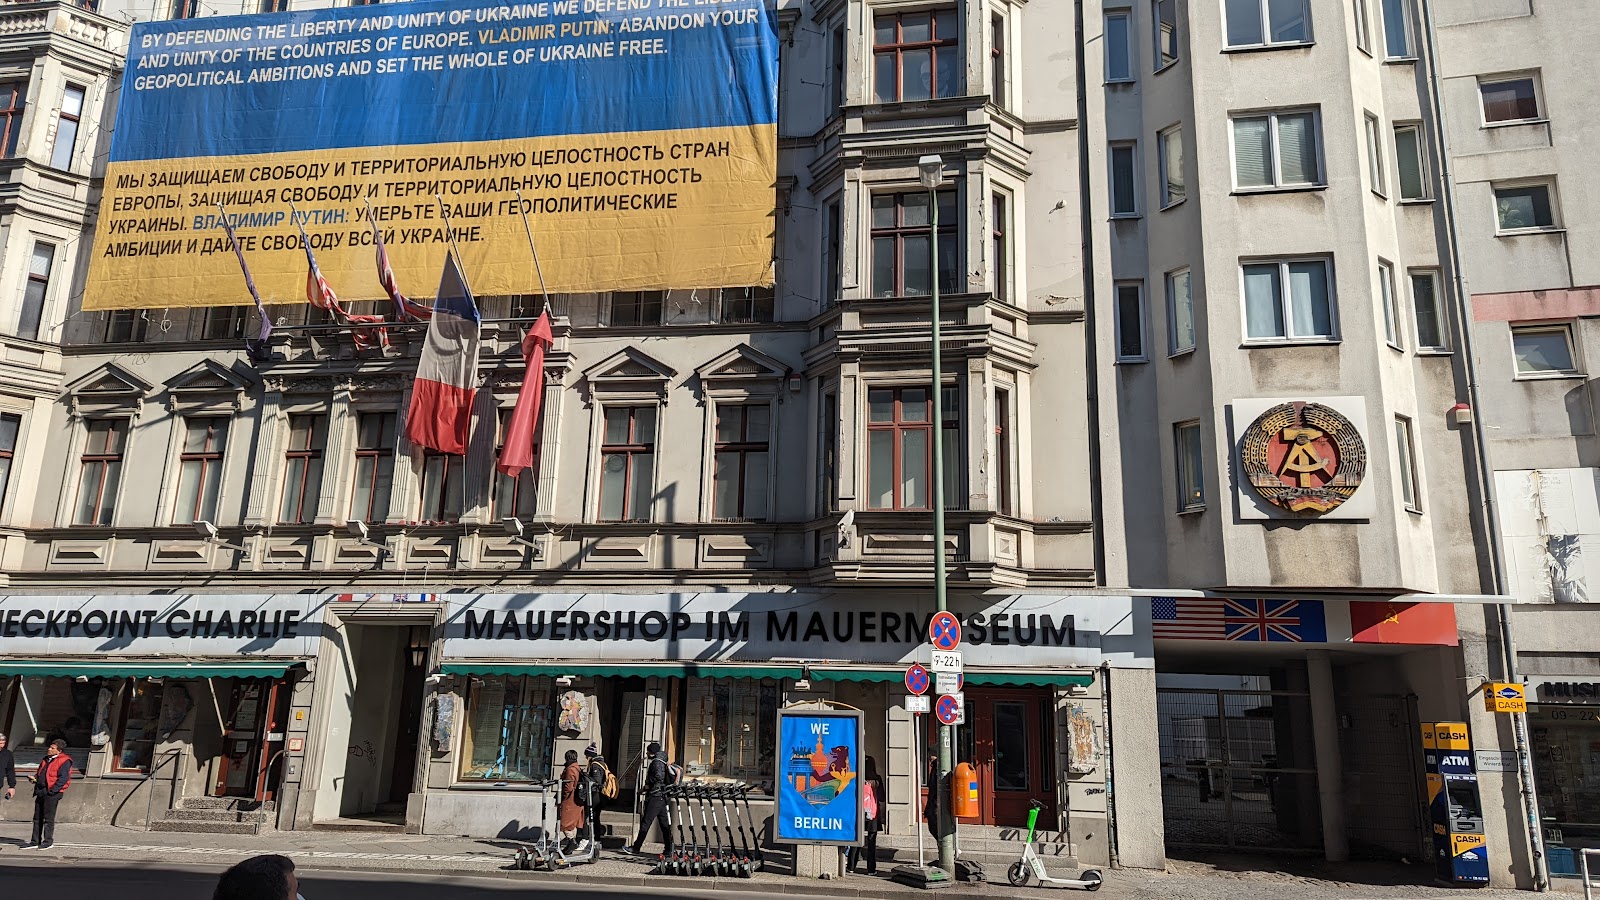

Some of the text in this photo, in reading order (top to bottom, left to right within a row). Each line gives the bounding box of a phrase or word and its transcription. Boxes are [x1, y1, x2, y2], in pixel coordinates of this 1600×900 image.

[137, 8, 759, 70] AND UNITY OF THE COUNTRIES OF EUROPE. VLADIMIR PUTIN: ABANDON YOUR
[142, 33, 163, 48] BY
[165, 26, 251, 46] DEFENDING
[256, 24, 286, 41] THE
[290, 18, 356, 38] LIBERTY
[359, 15, 393, 33] AND
[398, 11, 446, 31] UNITY
[449, 9, 471, 25] OF
[475, 4, 548, 22] UKRAINE
[553, 1, 579, 16] WE
[583, 0, 651, 14] DEFEND
[134, 38, 668, 91] GEOPOLITICAL AMBITIONS AND SET THE WHOLE OF UKRAINE FREE.
[117, 141, 730, 189] МЫ ЗАЩИЩАЕМ СВОБОДУ И ТЕРРИТОРИАЛЬНУЮ ЦЕЛОСТНОСТЬ СТРАН
[113, 168, 702, 212] ЕВРОПЫ, ЗАЩИЩАЯ СВОБОДУ И ТЕРРИТОРИАЛЬНУЮ ЦЕЛОСТНОСТЬ
[109, 216, 187, 235] УКРАИНЫ.
[193, 212, 285, 231] ВЛАДИМИР
[355, 204, 434, 222] УМЕРЬТЕ
[440, 202, 492, 219] ВАШИ
[499, 193, 678, 216] ГЕОПОЛИТИЧЕСКИЕ
[103, 239, 182, 258] АМБИЦИИ
[186, 239, 198, 254] И
[262, 232, 344, 251] СВОБОДУ
[349, 226, 395, 246] ВСЕЙ
[166, 609, 300, 639] CHARLIE
[464, 609, 1076, 646] MAUERSHOP IM MAUERMSEUM
[810, 723, 830, 735] WE
[1551, 710, 1567, 720] 09
[1580, 711, 1595, 720] 22
[1439, 732, 1466, 740] CASH
[1442, 756, 1469, 766] ATM
[794, 817, 842, 830] BERLIN
